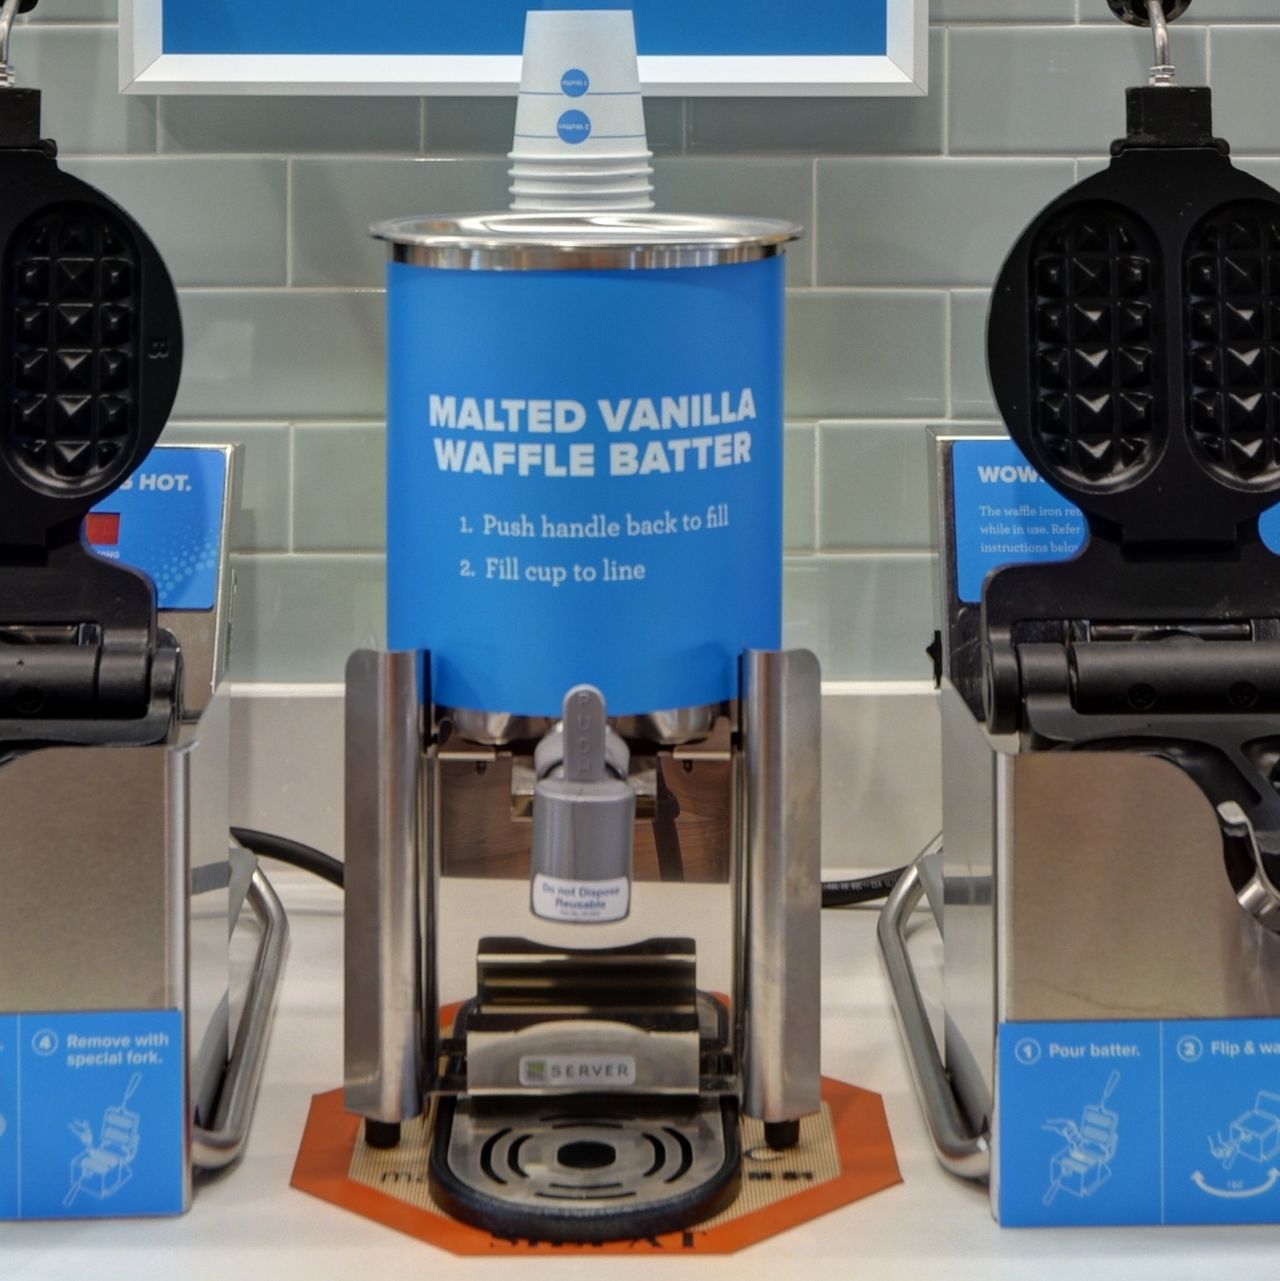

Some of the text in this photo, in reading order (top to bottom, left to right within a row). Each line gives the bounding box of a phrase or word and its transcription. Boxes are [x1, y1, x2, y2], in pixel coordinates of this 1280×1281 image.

[428, 388, 757, 433] MALTED VANILLA
[433, 431, 751, 477] WAFFLE BATTER
[139, 474, 192, 491] HOT.
[979, 506, 1002, 516] The
[1005, 507, 1037, 516] waffle
[1040, 508, 1062, 516] iron
[460, 504, 729, 538] 1. Push handle back to fill
[980, 524, 1081, 535] while in use. Refer
[981, 542, 1048, 552] instructions
[460, 558, 646, 587] 2. Fill cup to line
[67, 1034, 130, 1048] Remove
[135, 1032, 169, 1046] with
[1050, 1044, 1086, 1058] Pour
[1090, 1042, 1140, 1057] batter.
[1212, 1040, 1238, 1058] Flip
[1244, 1041, 1255, 1053] &
[67, 1051, 162, 1068] special fork.
[551, 1064, 629, 1077] SERVER
